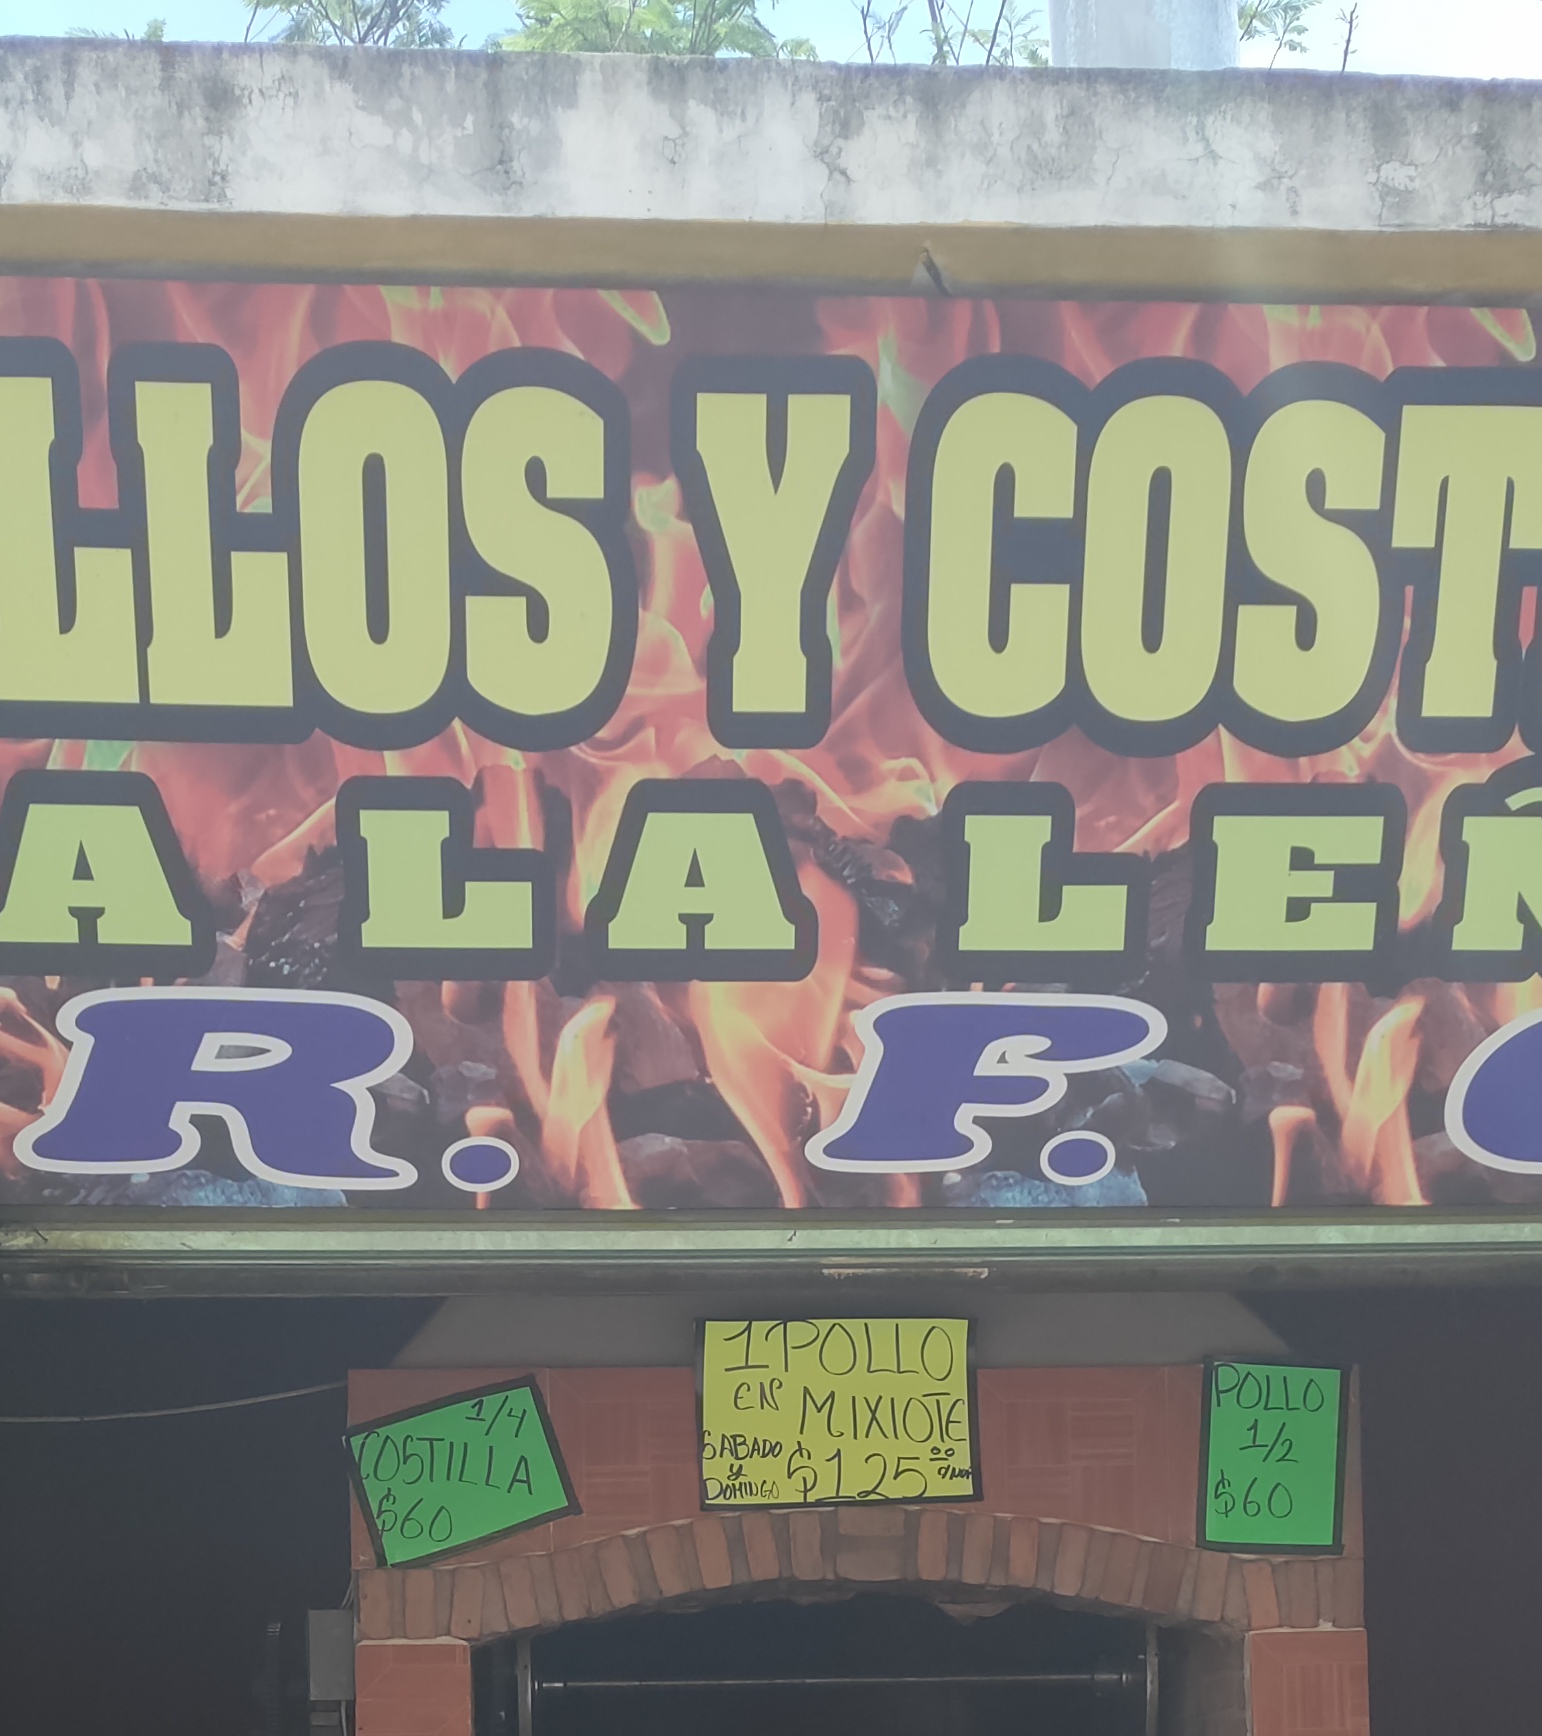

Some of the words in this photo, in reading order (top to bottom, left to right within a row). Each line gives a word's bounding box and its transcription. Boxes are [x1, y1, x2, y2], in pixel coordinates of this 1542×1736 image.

[695, 392, 851, 713] Y
[359, 809, 797, 950] LA
[765, 1319, 954, 1381] POLLO
[733, 1377, 783, 1411] EN
[799, 1385, 967, 1443] MIXIOTE
[1214, 1362, 1325, 1413] POLLO
[464, 1394, 527, 1438] 1/4
[1238, 1418, 1299, 1464] 1/2
[360, 1431, 533, 1496] COSTILLA
[701, 1429, 783, 1461] SABADO
[375, 1487, 454, 1543] $60
[702, 1476, 781, 1502] DOMINGO
[1213, 1468, 1294, 1519] $60
